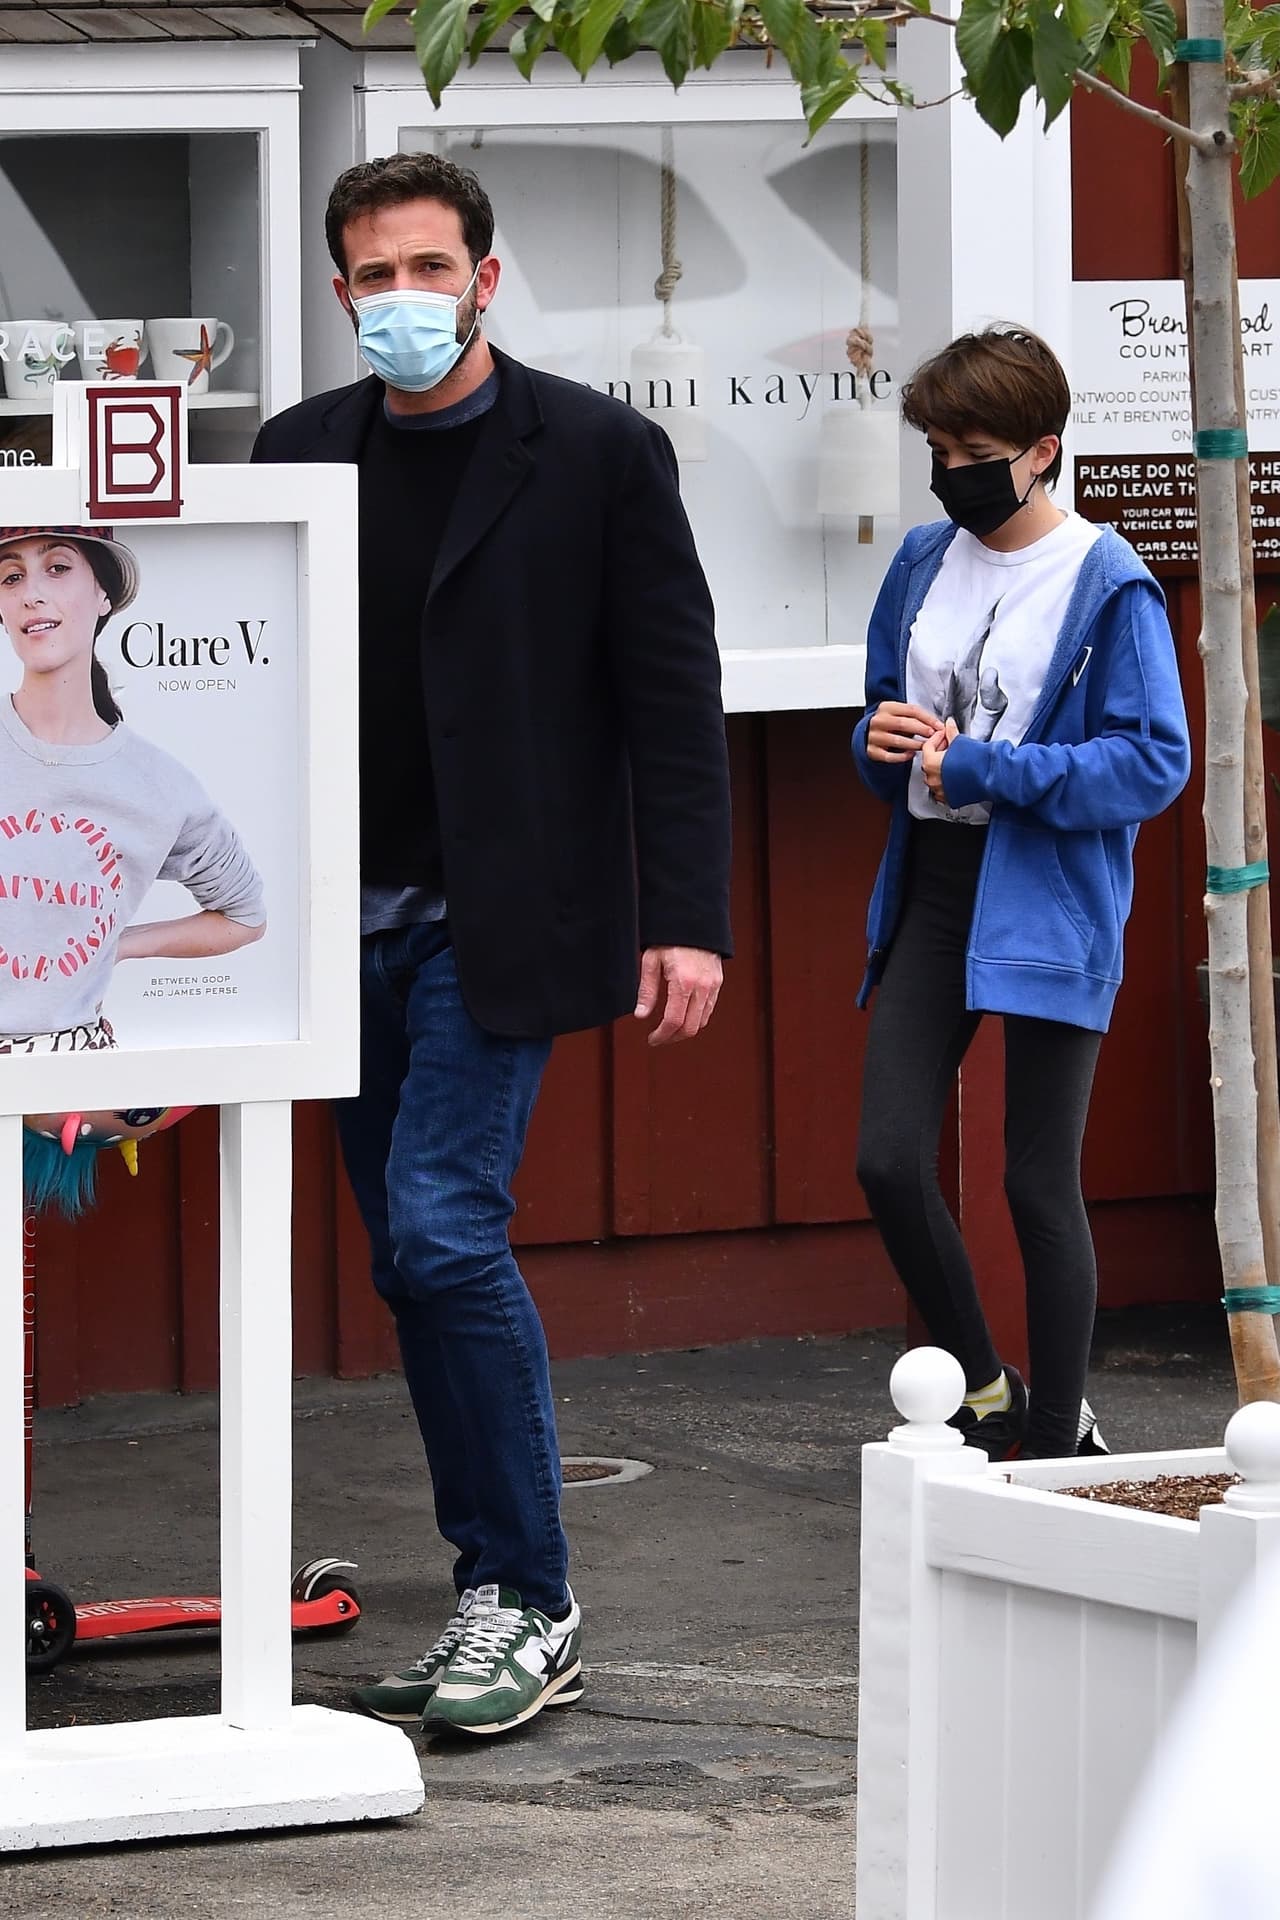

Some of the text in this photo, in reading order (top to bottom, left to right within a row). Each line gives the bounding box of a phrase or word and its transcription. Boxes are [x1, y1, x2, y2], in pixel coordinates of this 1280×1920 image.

[1103, 411, 1119, 423] AT
[1079, 464, 1142, 480] PLEASE
[1146, 464, 1170, 478] DO
[1083, 484, 1118, 498] AND
[1122, 482, 1174, 497] LEAVE
[1122, 508, 1150, 518] YOUR
[1151, 507, 1172, 517] CAR
[1122, 520, 1173, 530] VEHICLE
[1136, 541, 1168, 551] CARS
[120, 620, 269, 668] Clare V.
[158, 679, 236, 692] NOW OPEN
[151, 975, 231, 986] BETWEEN GOOP
[142, 986, 238, 998] AND JAMES PERSE
